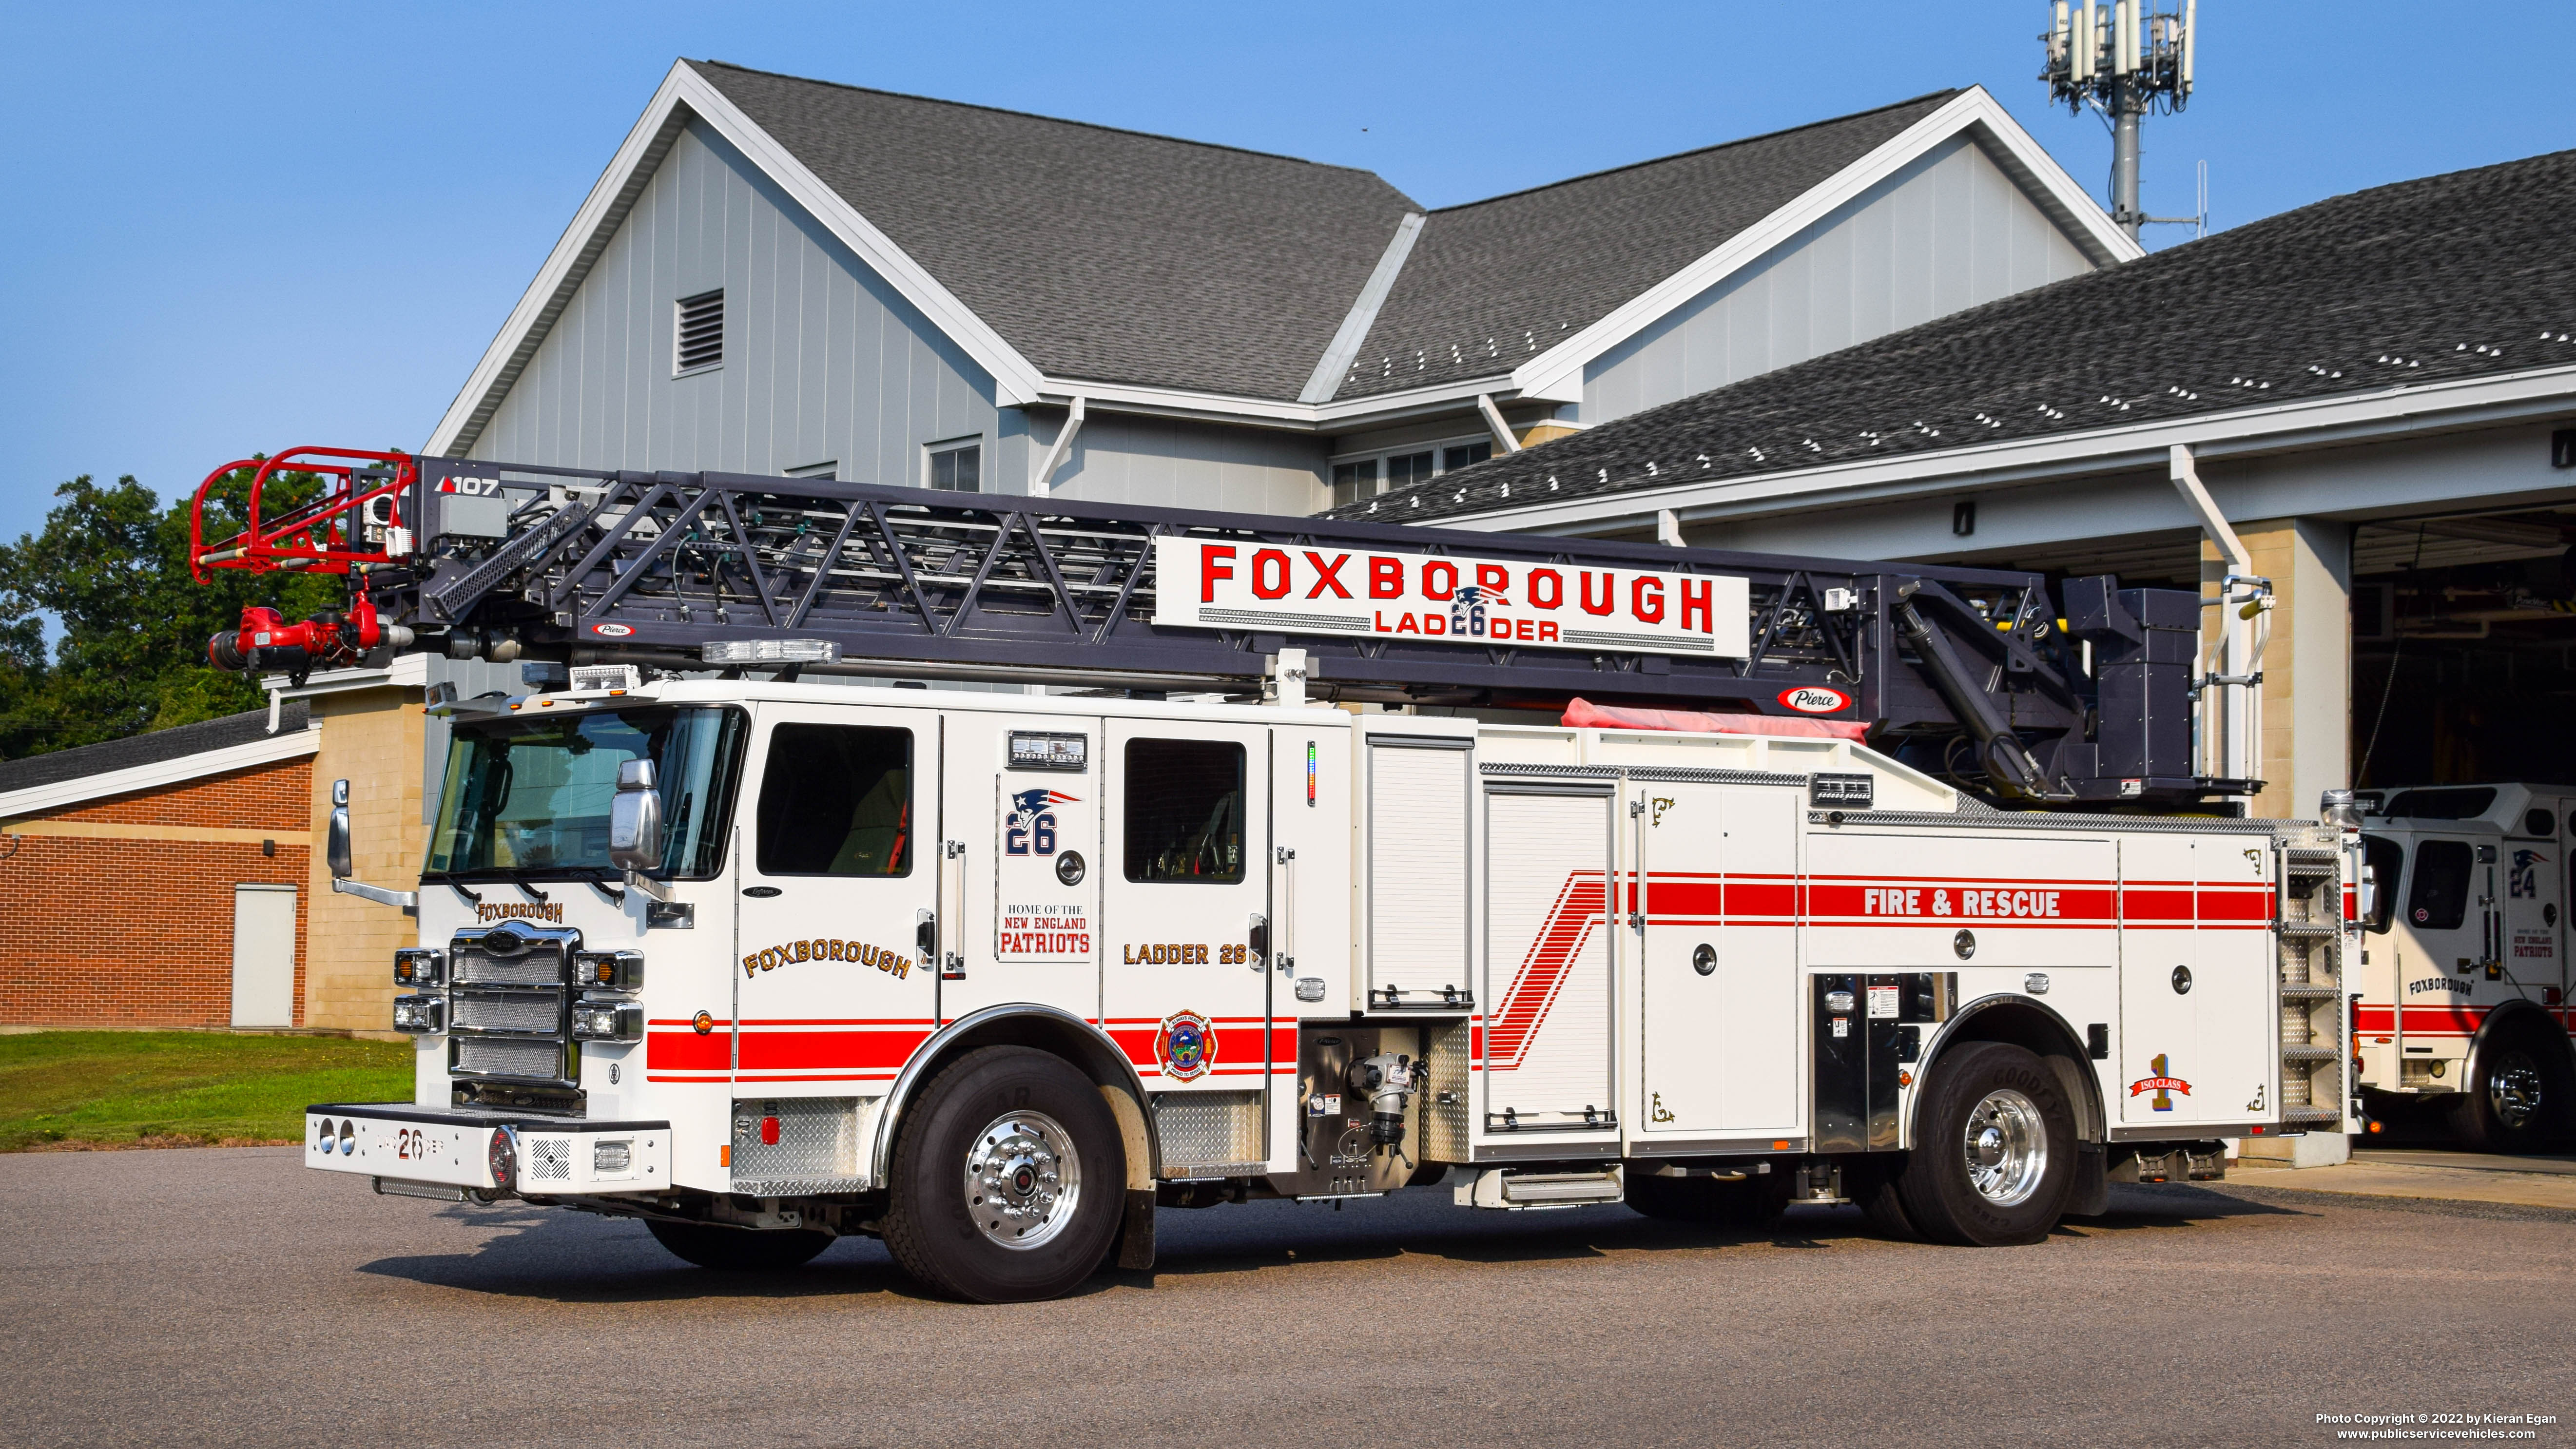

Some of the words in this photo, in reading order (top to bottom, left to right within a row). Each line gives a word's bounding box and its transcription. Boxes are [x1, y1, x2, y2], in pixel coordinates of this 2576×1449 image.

[452, 476, 499, 496] 107
[1201, 543, 1713, 634] FOXBOROUGH
[1795, 690, 1834, 707] Pierce
[1006, 811, 1057, 857] 26
[2510, 868, 2536, 899] 24
[1008, 905, 1041, 914] HOME
[1045, 905, 1059, 914] OF
[1061, 905, 1083, 915] THE
[1864, 889, 1921, 915] FIRE
[1932, 889, 1952, 915] &
[1963, 890, 2060, 917] RESCUE
[478, 903, 563, 925] FOXBOROUGH
[1005, 917, 1028, 929] NEW
[1034, 917, 1086, 929] ENGLAND
[1000, 932, 1090, 954] PATRIOTS
[2514, 946, 2553, 958] PATRIOTS
[742, 939, 912, 980] FOXBOROUGH
[1123, 944, 1209, 965] LADDER
[1220, 944, 1247, 965] 26
[2409, 978, 2472, 996] FOXBOROUGH
[1172, 1016, 1187, 1025] ALWAYS
[1188, 1016, 1201, 1024] READY
[1171, 1067, 1183, 1077] PROUD
[1190, 1067, 1201, 1076] SERVE
[2140, 1080, 2155, 1090] ISO
[2156, 1079, 2181, 1089] CLASS
